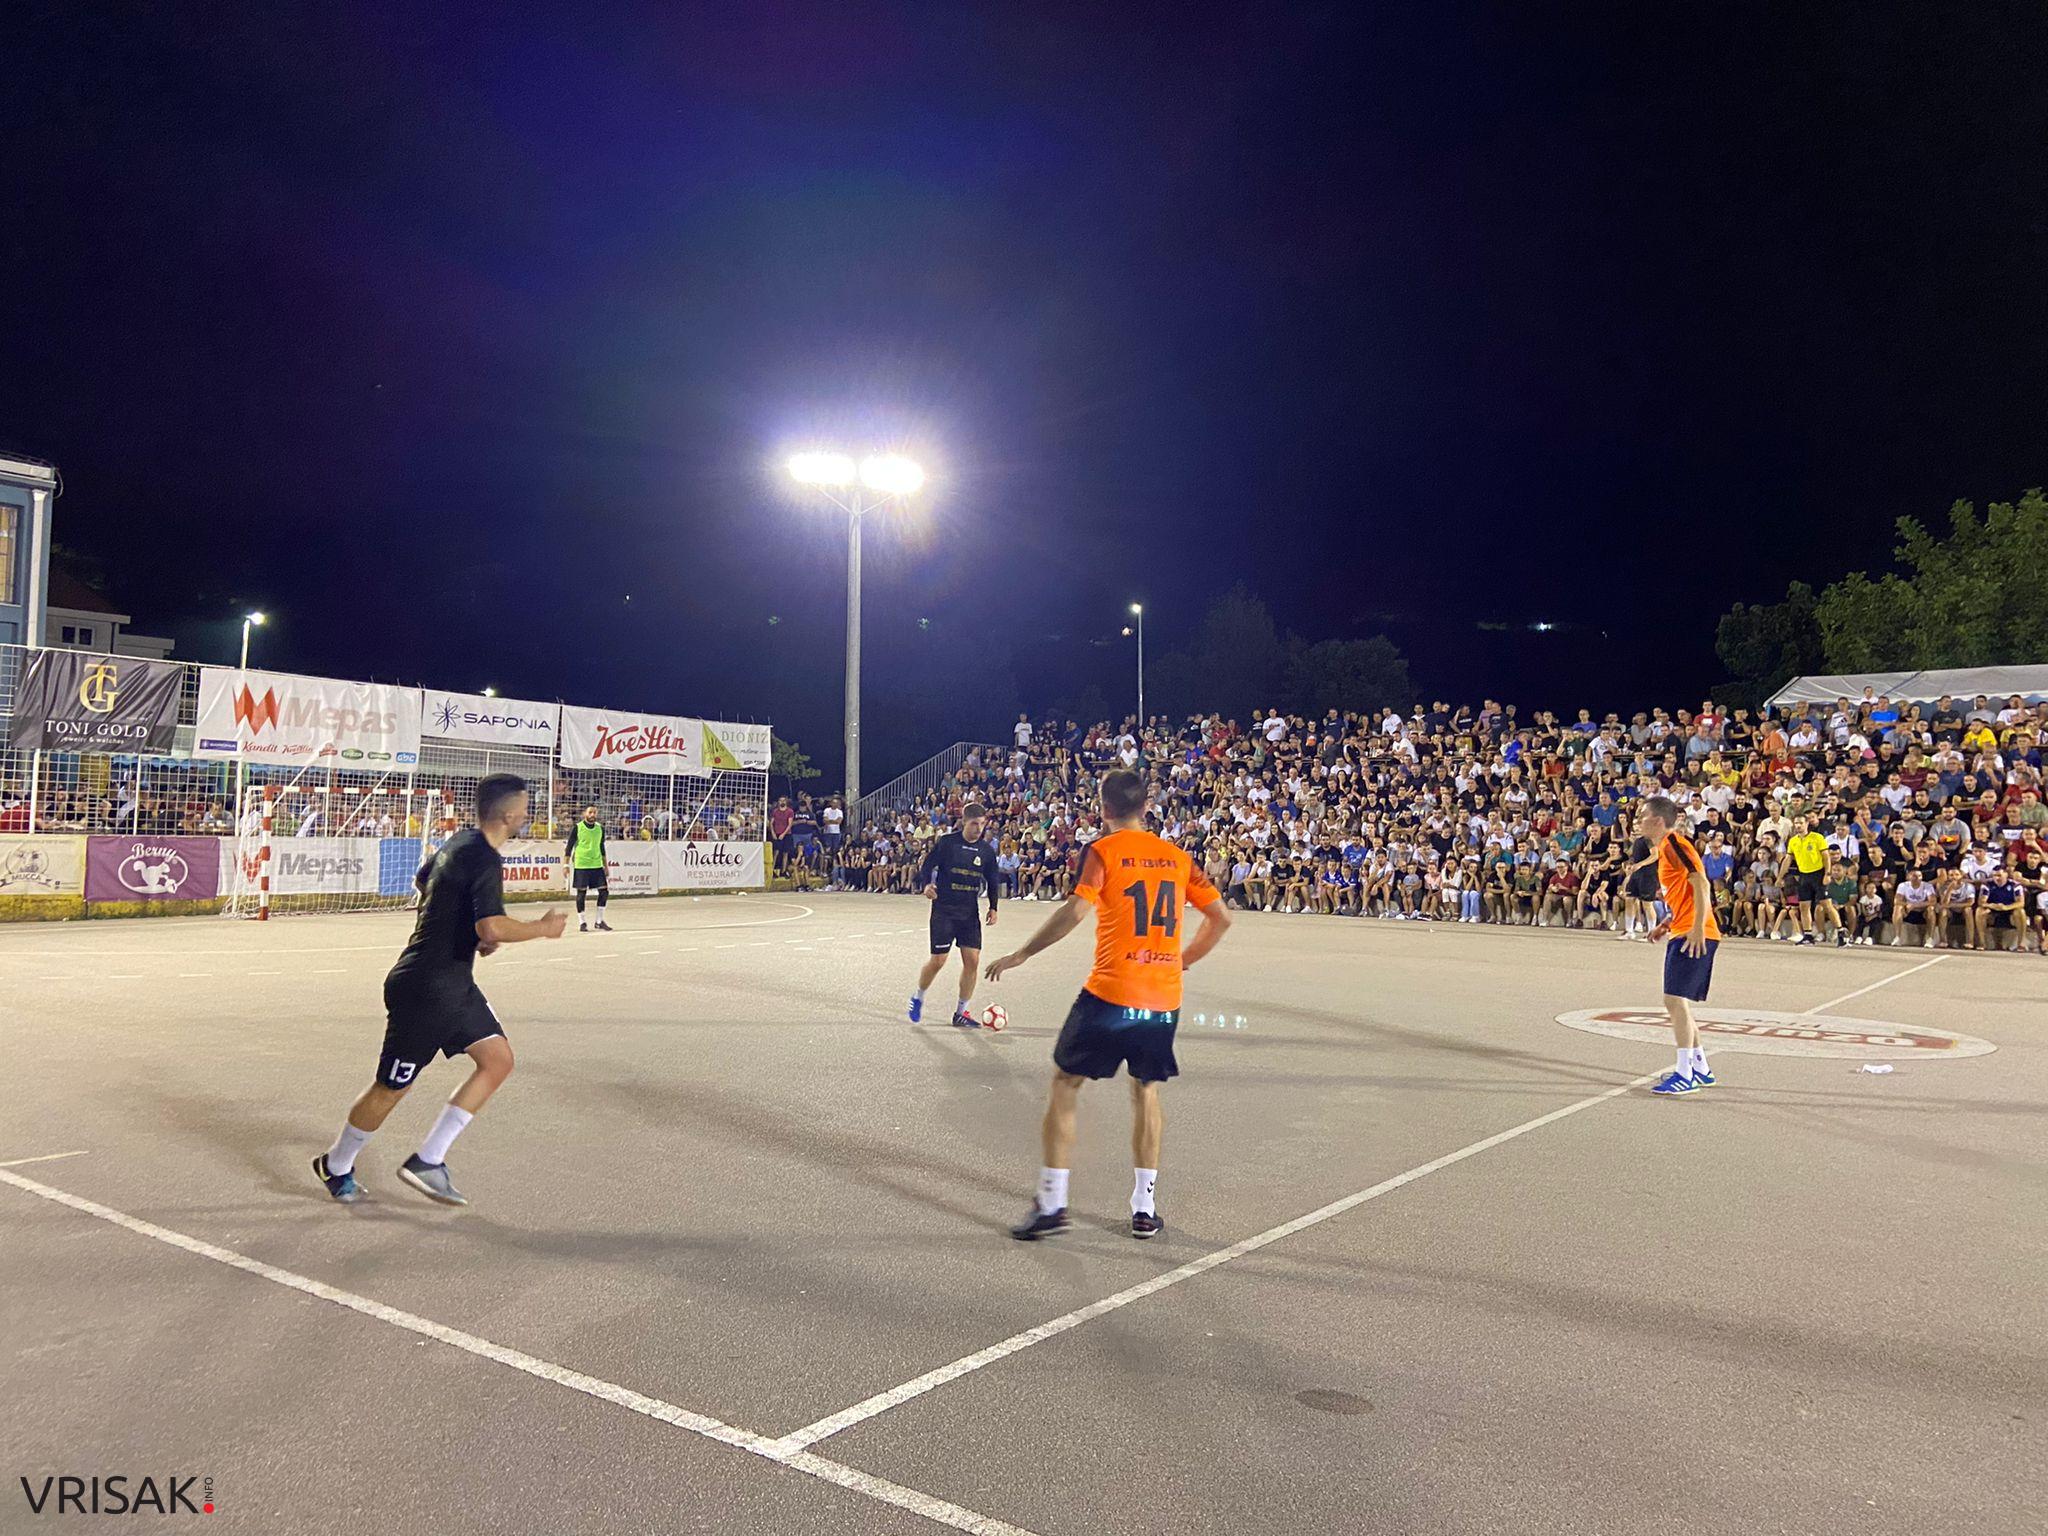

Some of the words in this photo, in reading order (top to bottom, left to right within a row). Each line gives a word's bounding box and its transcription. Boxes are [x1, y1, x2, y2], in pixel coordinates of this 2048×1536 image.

[283, 697, 398, 740] Mepas
[464, 713, 551, 730] SAPONIA
[45, 720, 89, 735] TONI
[97, 722, 148, 738] GOLD
[721, 731, 768, 744] DIONIZ
[243, 741, 278, 752] Kandit
[592, 725, 688, 760] Koestlin
[131, 842, 177, 862] Berny
[501, 854, 532, 864] zerski
[534, 854, 561, 864] salon
[278, 853, 364, 882] Mepas
[687, 870, 742, 879] RESTAURANT
[1123, 880, 1177, 938] 14
[389, 1058, 416, 1083] 13
